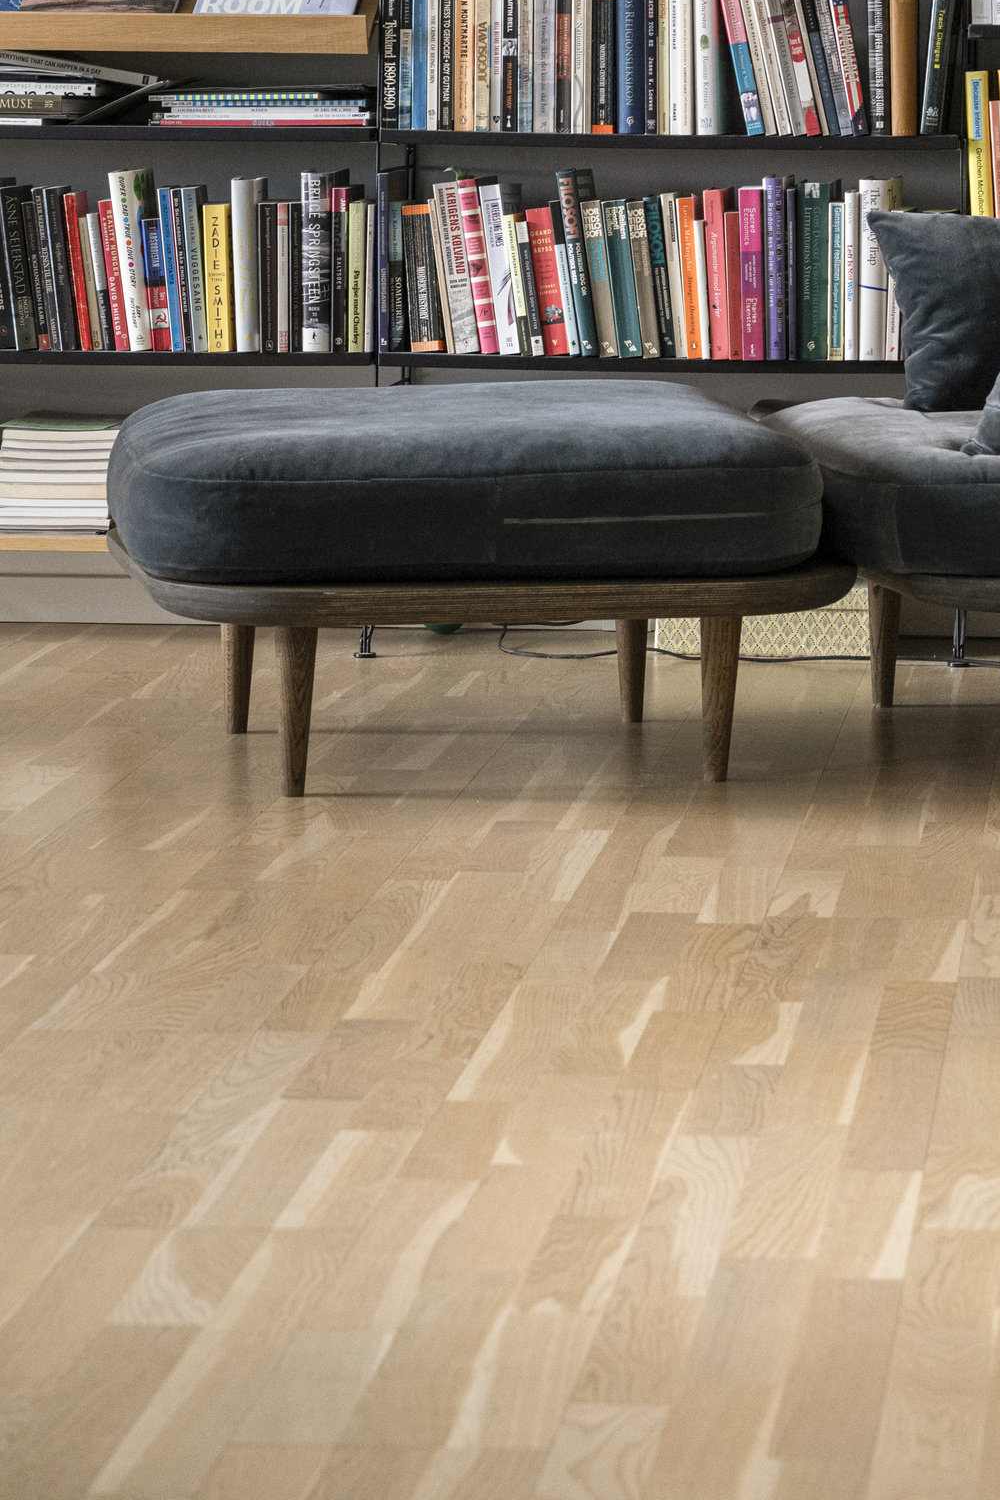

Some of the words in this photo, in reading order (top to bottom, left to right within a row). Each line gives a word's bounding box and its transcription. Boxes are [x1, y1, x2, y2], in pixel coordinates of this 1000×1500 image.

[384, 20, 398, 59] Tyskland
[478, 21, 487, 82] JUGOSLAVIA
[57, 63, 78, 71] HAPPEN
[384, 61, 396, 110] 1890-1990
[972, 81, 980, 111] Because
[975, 148, 983, 179] Gretchen
[309, 179, 321, 219] BRUCE
[447, 192, 460, 232] KRIGENS
[559, 178, 579, 239] FILOSOFI
[211, 216, 220, 270] ZADIE
[308, 223, 321, 304] SPRINGSTEEN
[451, 234, 465, 275] KØLVAND
[213, 285, 224, 340] SMITH
